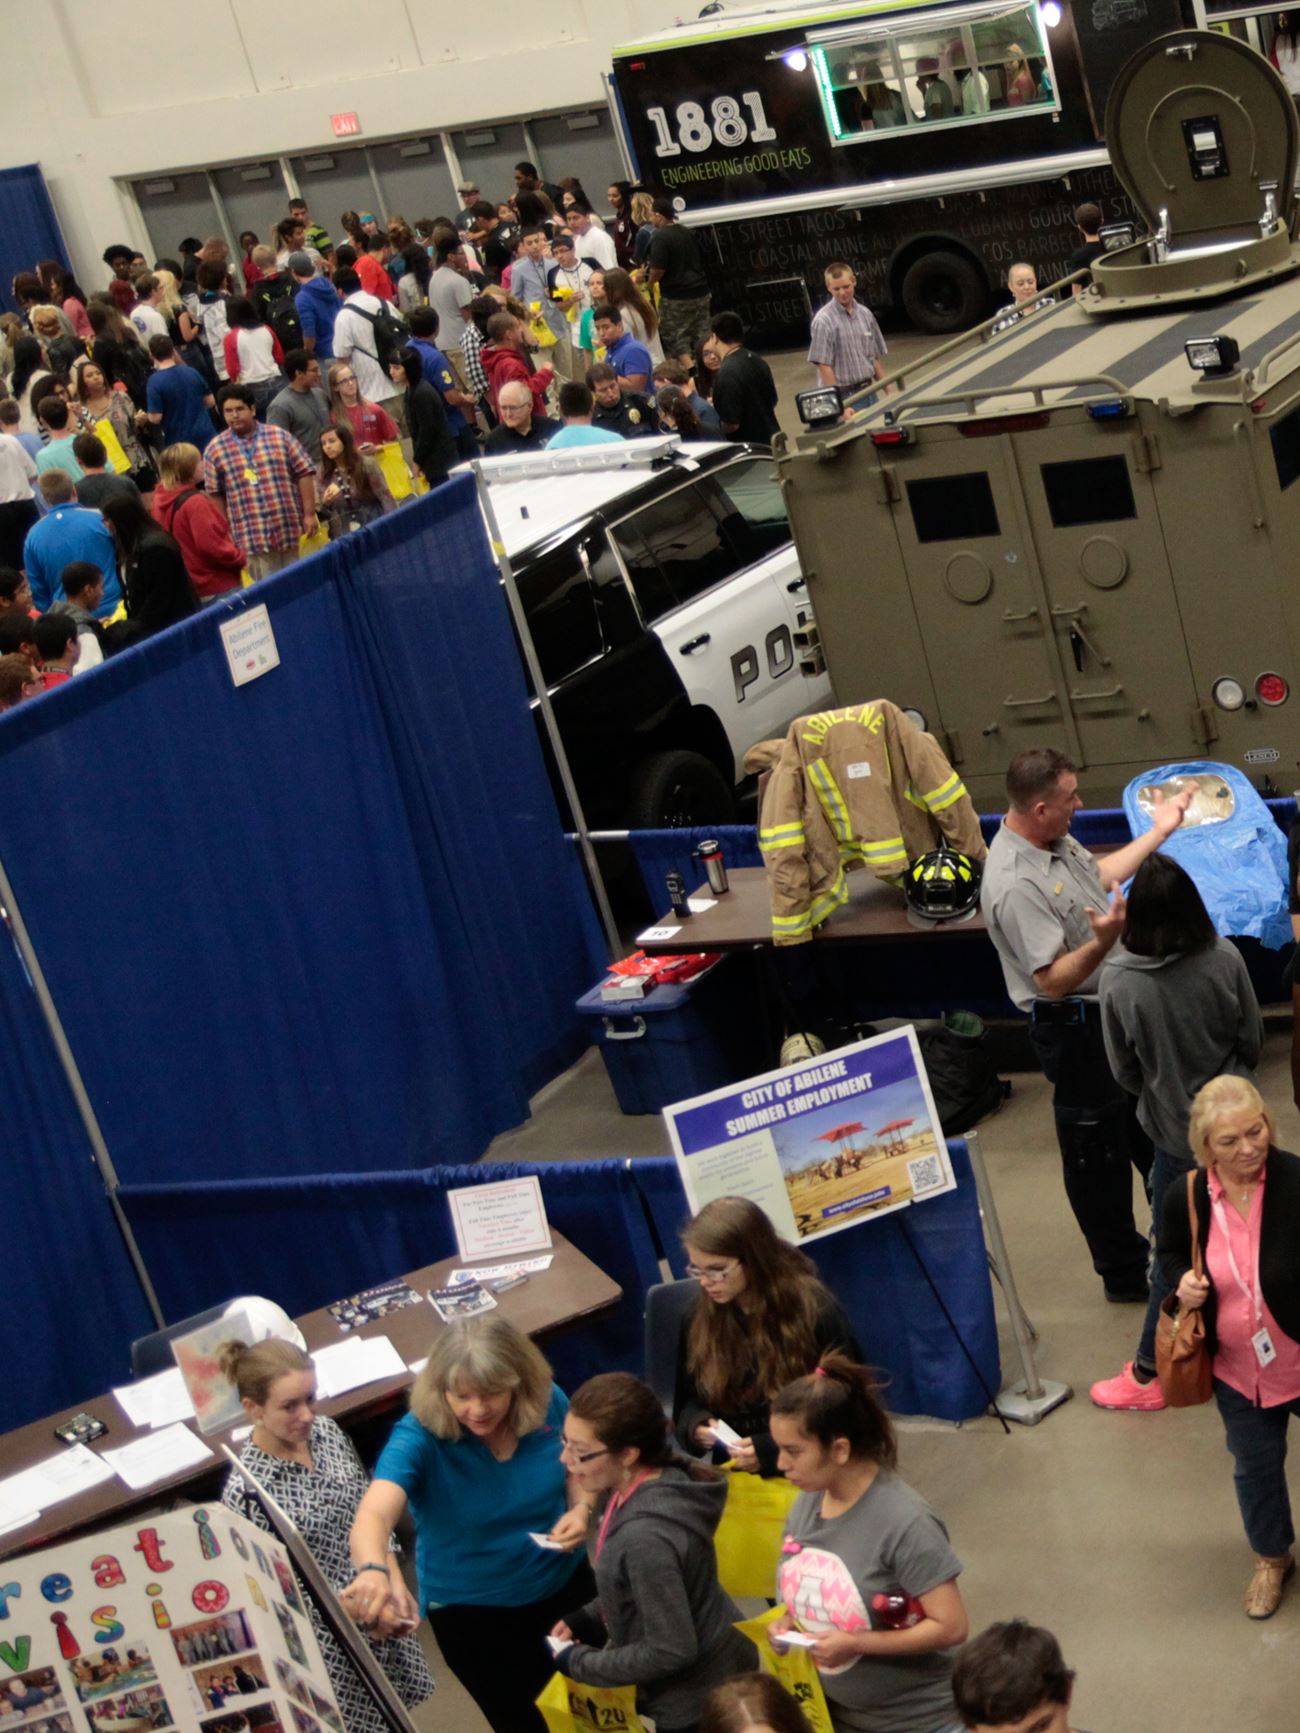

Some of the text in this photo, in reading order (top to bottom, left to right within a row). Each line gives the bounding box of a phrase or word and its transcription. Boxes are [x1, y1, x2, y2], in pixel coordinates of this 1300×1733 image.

[647, 91, 777, 157] 1881
[661, 147, 812, 189] ENGINEERING GOOD EATS
[738, 217, 793, 245] STREET
[799, 210, 846, 238] TACOS
[1017, 231, 1079, 259] BARBEC
[748, 240, 816, 270] COASTAL
[817, 232, 869, 261] MAINE
[802, 704, 885, 746] ABILENE
[725, 1073, 873, 1137] SUMMER EMPLOYMENT
[741, 1060, 848, 1109] CITY OF ABILENE
